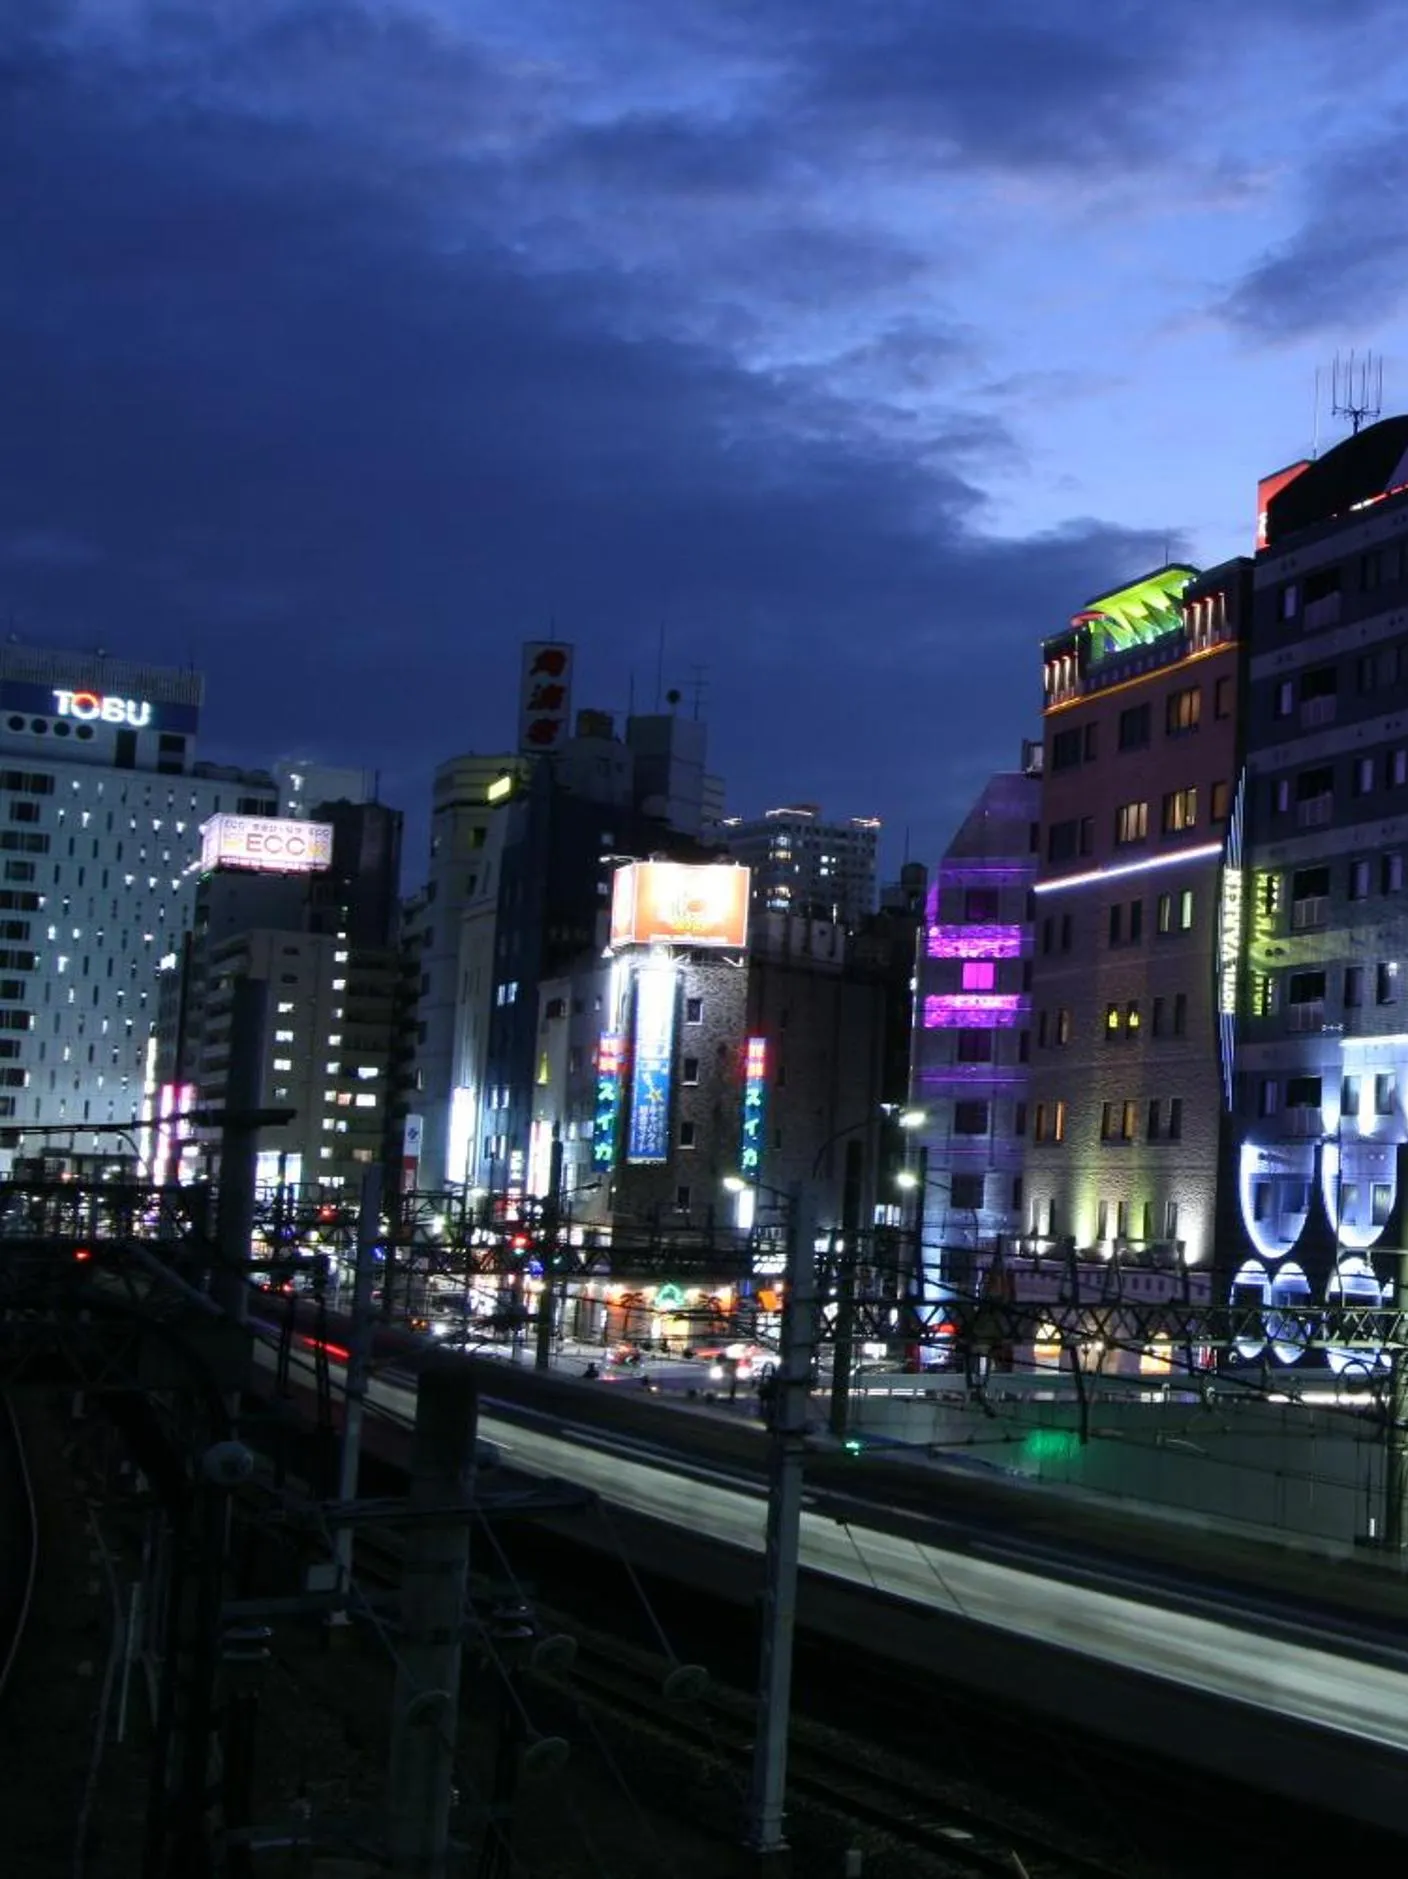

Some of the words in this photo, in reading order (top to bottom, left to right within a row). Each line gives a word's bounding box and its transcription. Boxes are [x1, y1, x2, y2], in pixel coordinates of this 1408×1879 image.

[52, 687, 152, 727] TOBU
[245, 832, 306, 856] ECC
[1222, 964, 1236, 1015] HOTEL
